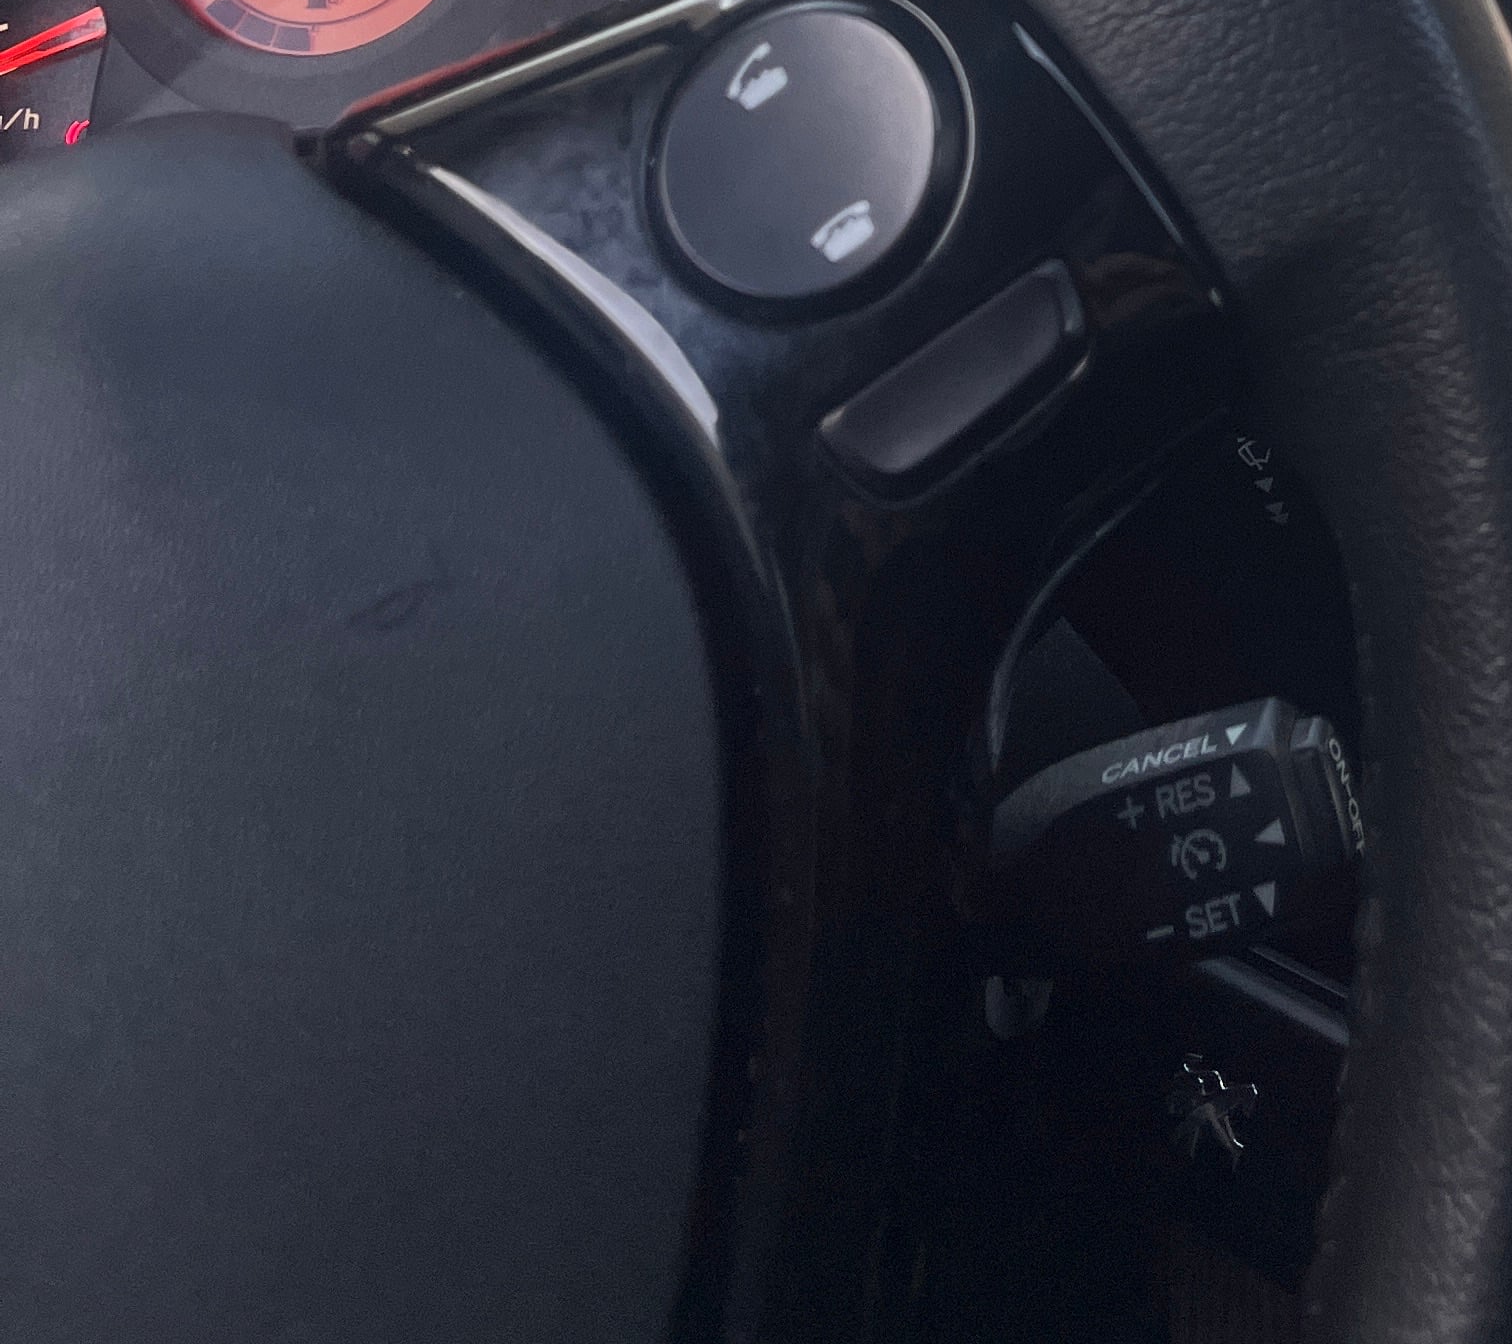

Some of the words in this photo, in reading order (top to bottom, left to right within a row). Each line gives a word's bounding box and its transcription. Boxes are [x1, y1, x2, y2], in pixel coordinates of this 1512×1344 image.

[1101, 735, 1217, 786] CANCEL
[1155, 771, 1216, 817] RES
[1184, 894, 1242, 941] SET
